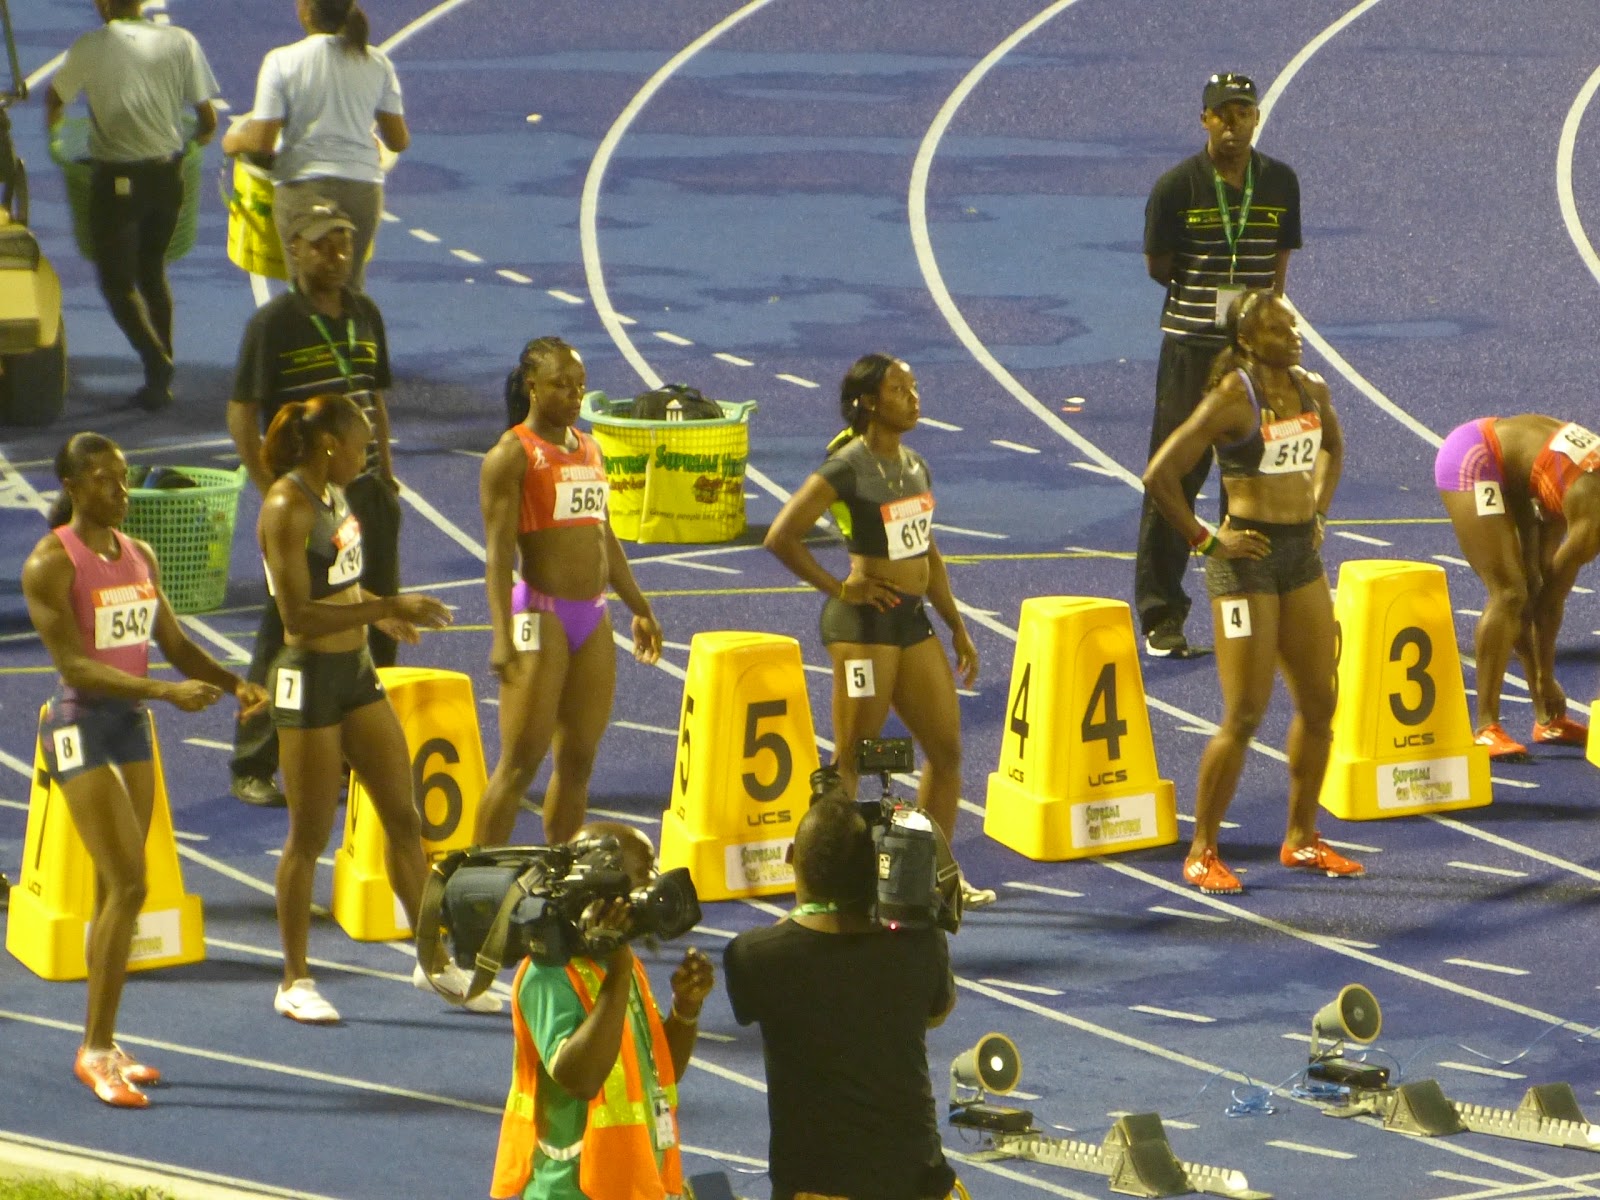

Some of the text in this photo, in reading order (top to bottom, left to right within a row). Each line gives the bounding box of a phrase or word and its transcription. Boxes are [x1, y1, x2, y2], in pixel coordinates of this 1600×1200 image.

[1275, 438, 1313, 466] 512
[1484, 487, 1496, 507] 2
[112, 606, 148, 640] 542
[1231, 607, 1242, 629] 4
[521, 620, 531, 642] 6
[853, 667, 866, 688] 5
[1389, 626, 1436, 726] 3
[285, 677, 294, 699] 7
[1010, 662, 1031, 760] 4
[1081, 662, 1128, 761] 4
[62, 736, 73, 759] 8
[680, 694, 695, 797] 5
[741, 699, 793, 802] 5
[1393, 732, 1436, 749] UCS
[412, 737, 463, 842] 6
[1088, 769, 1129, 788] UCS
[746, 809, 792, 827] UCS
